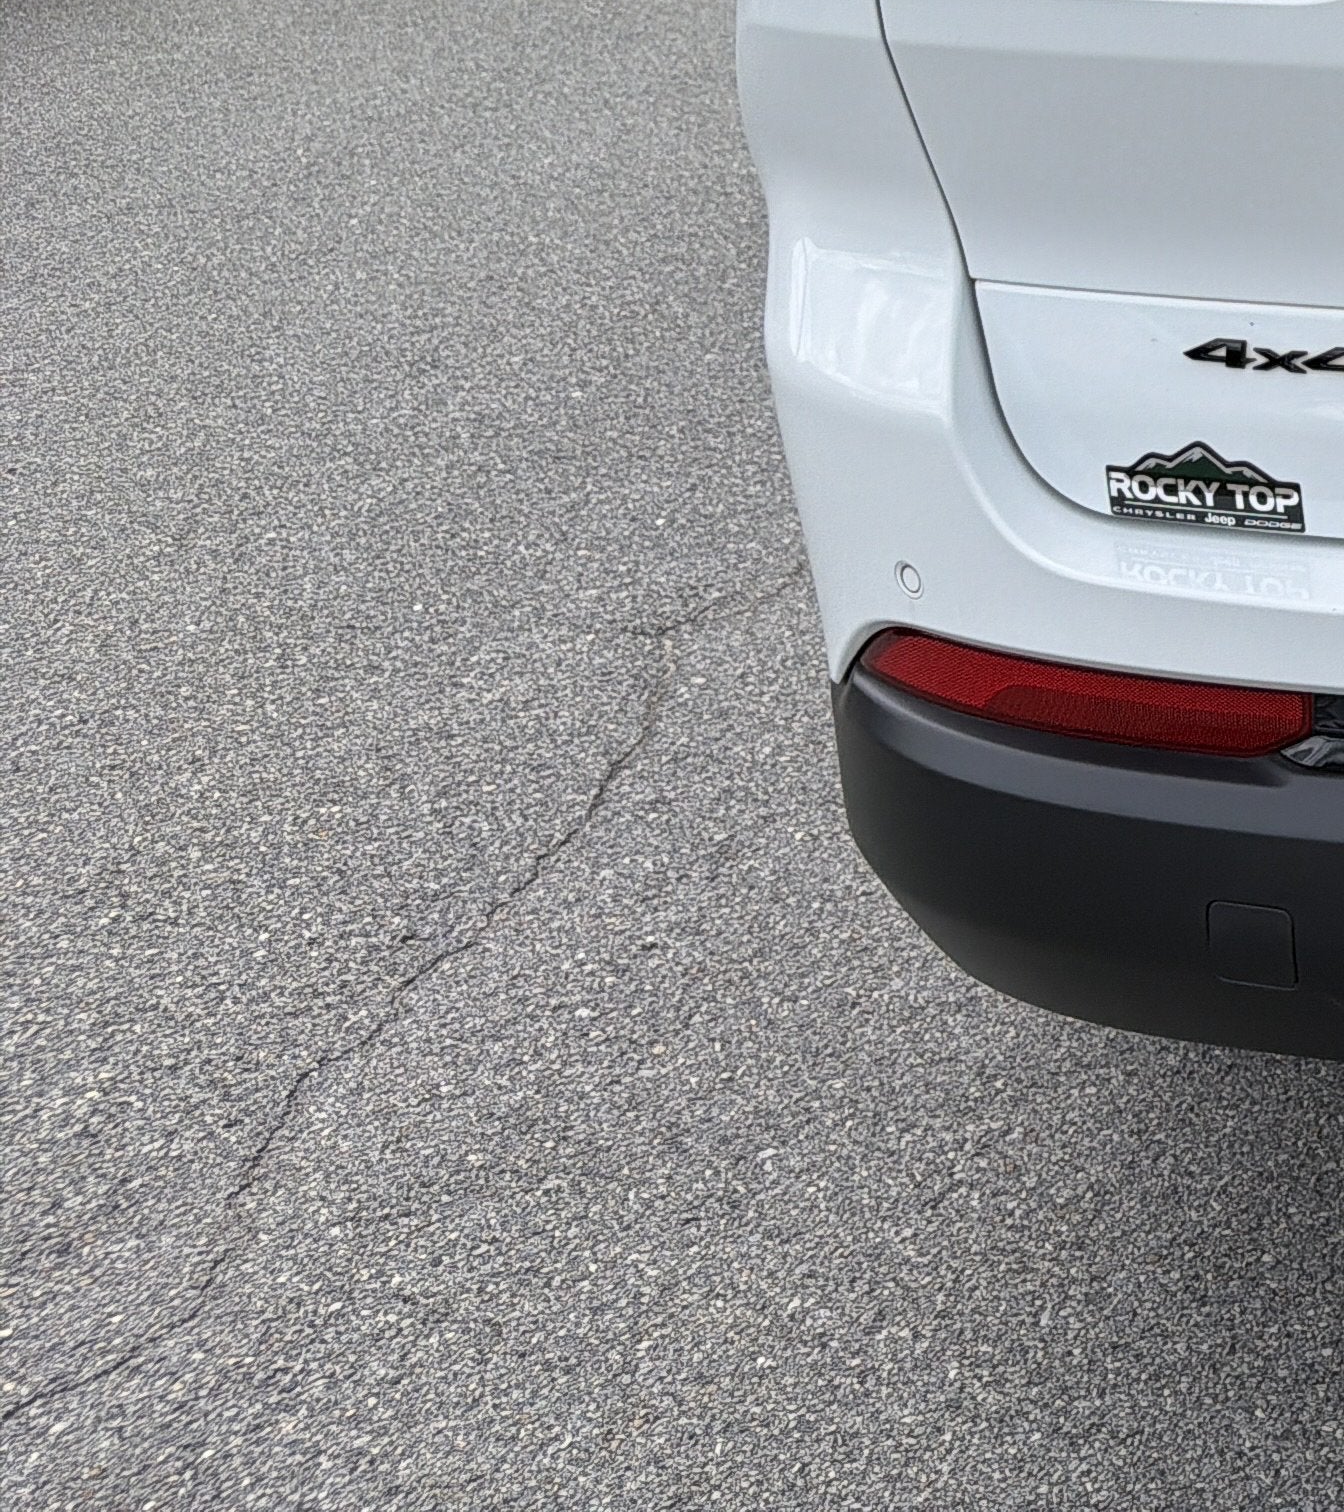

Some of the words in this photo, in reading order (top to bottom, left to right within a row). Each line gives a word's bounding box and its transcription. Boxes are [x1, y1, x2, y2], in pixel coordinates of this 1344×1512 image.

[1109, 471, 1221, 507] ROCKY
[1226, 483, 1300, 513] TOP
[1112, 506, 1197, 521] CHRYSLER
[1204, 512, 1236, 526] Jeep
[1244, 519, 1302, 530] DODGE
